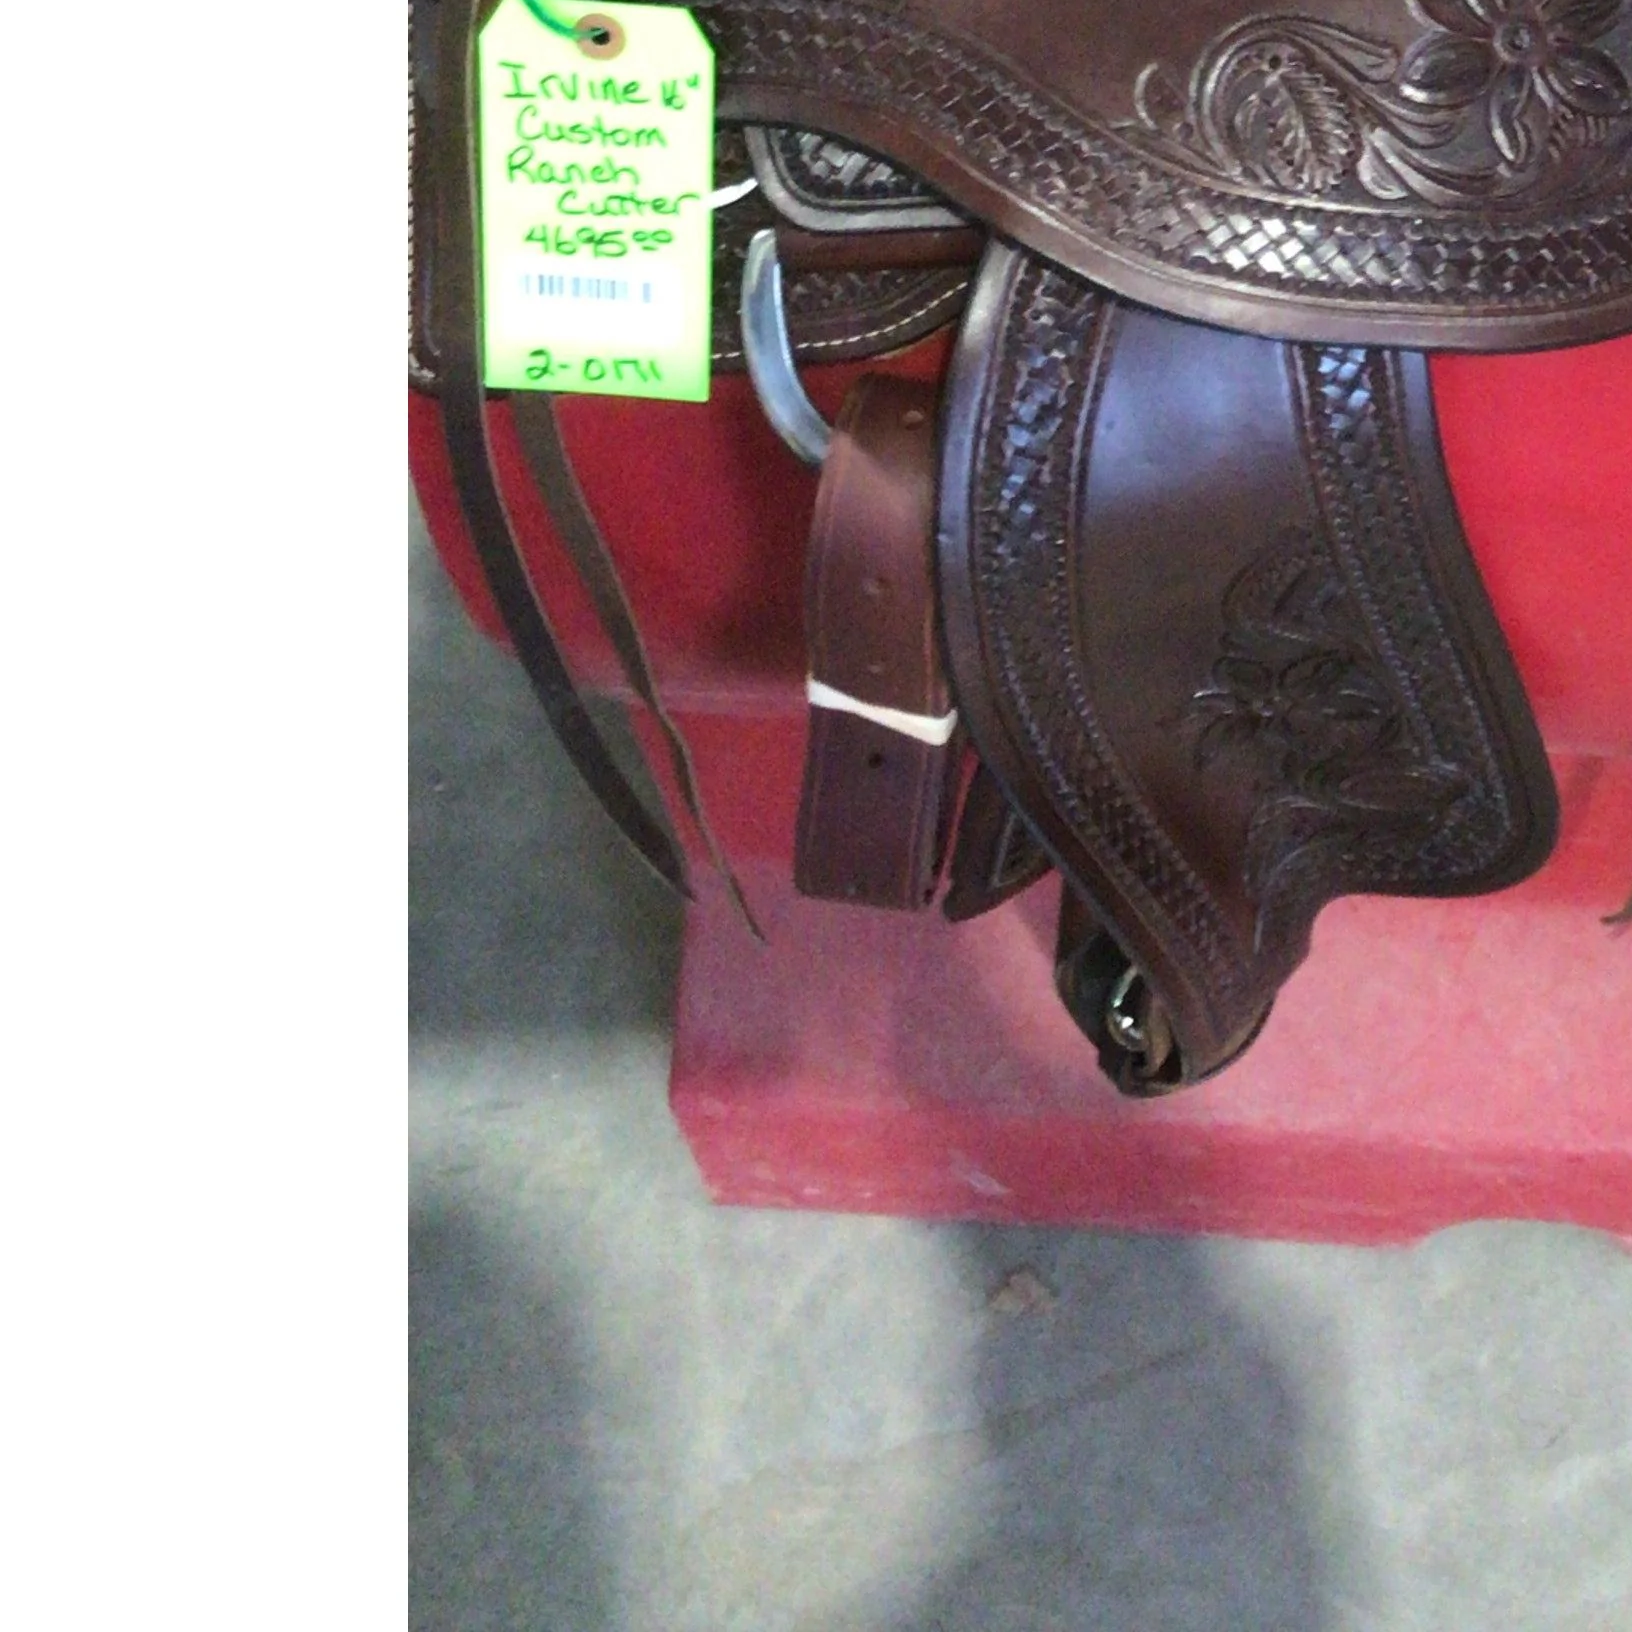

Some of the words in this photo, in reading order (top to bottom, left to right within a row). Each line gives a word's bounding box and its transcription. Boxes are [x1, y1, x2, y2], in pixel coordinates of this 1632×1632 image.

[498, 62, 650, 104] Irvine
[516, 104, 668, 148] Custom
[507, 145, 640, 185] Ranch
[557, 189, 700, 216] Cutter
